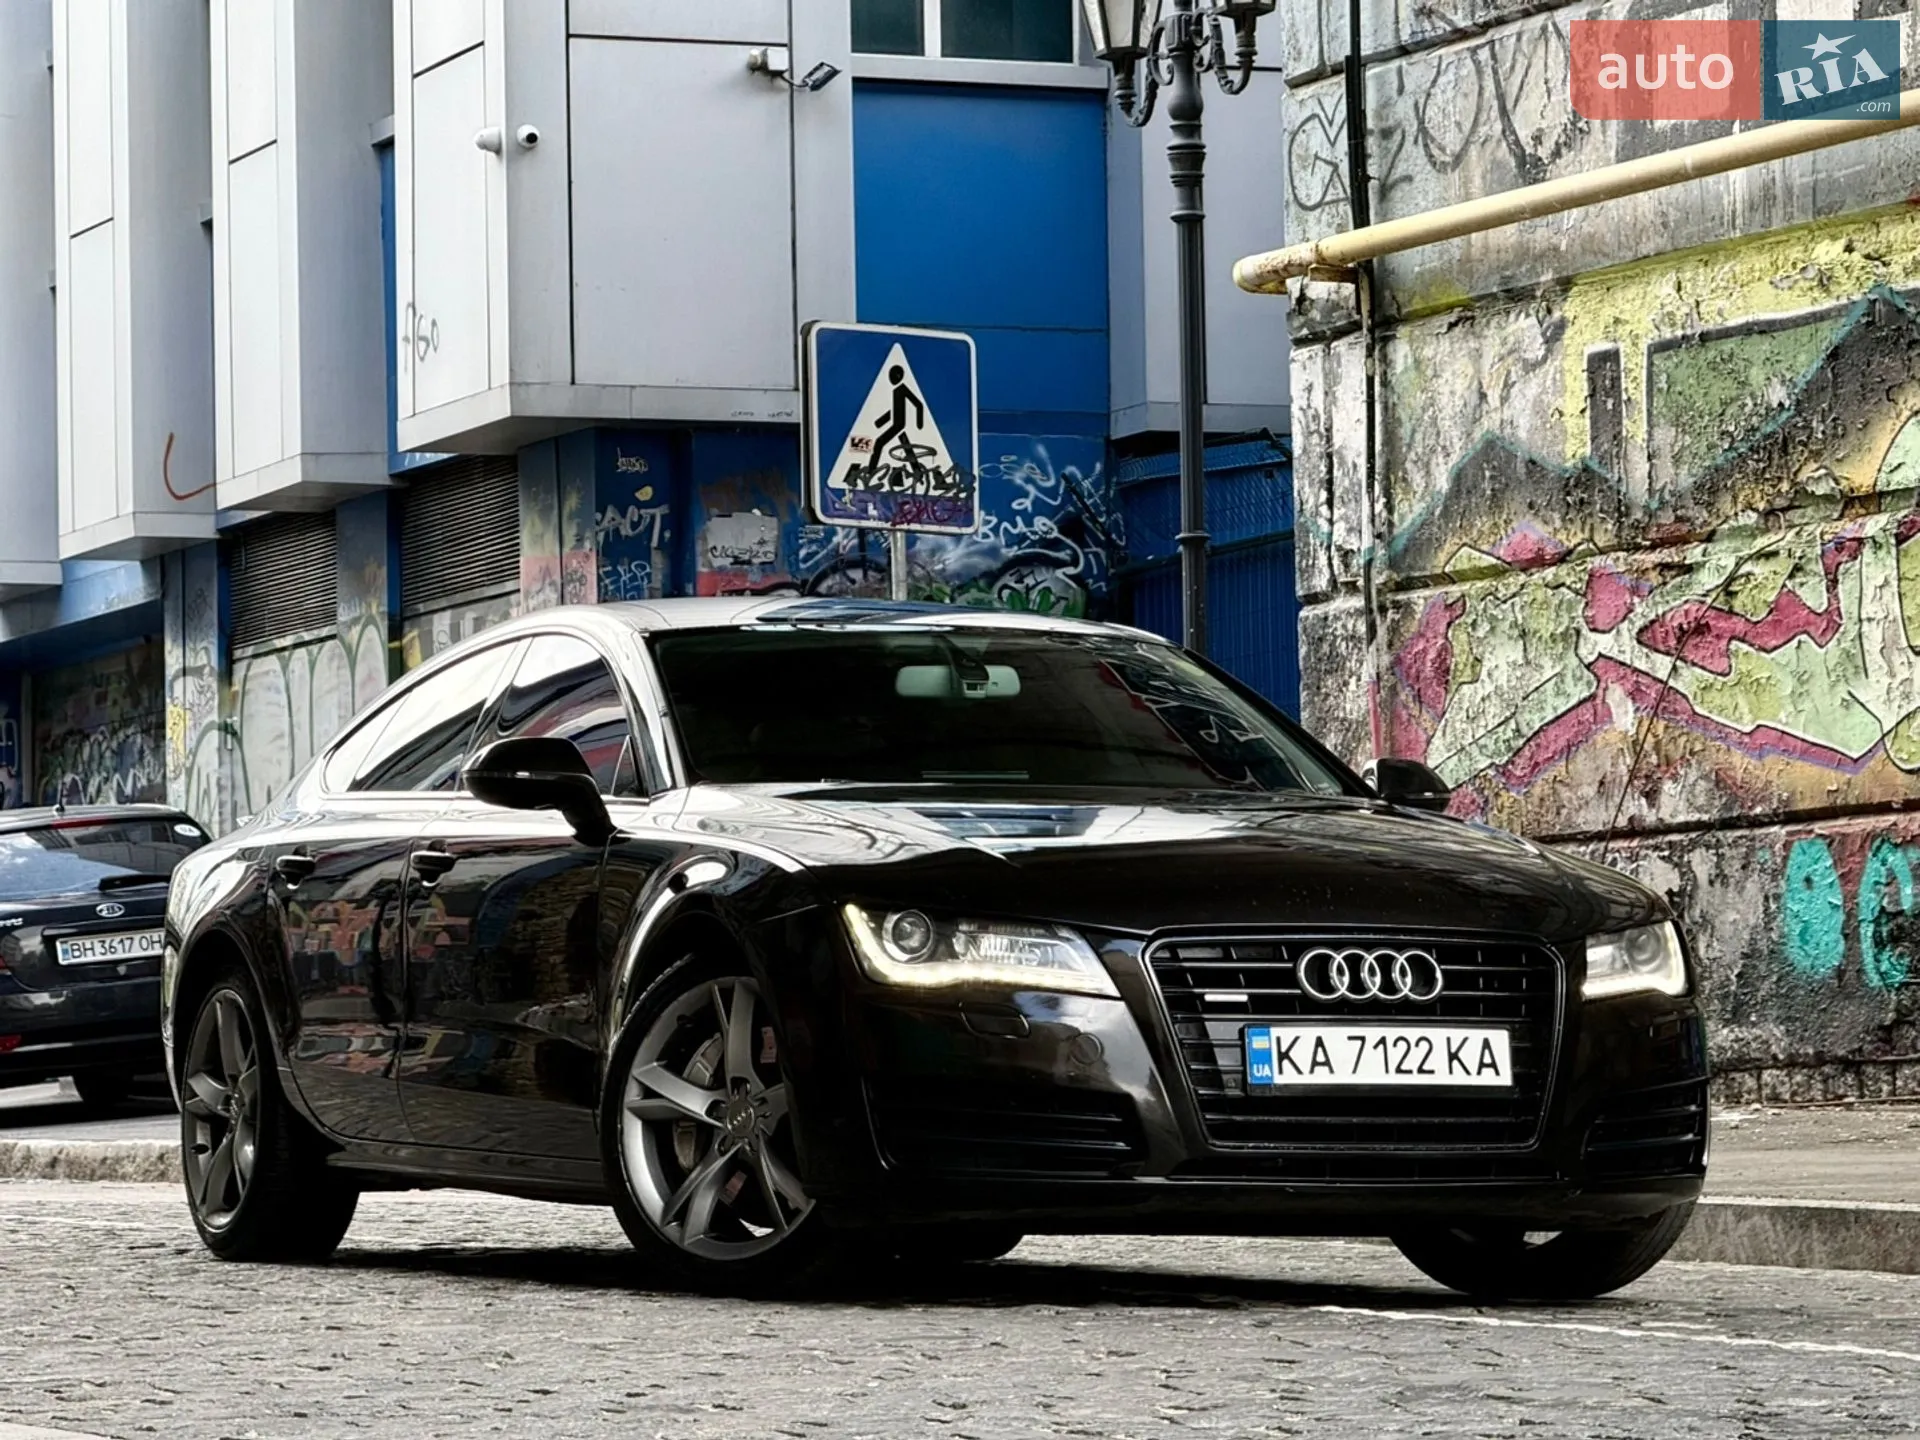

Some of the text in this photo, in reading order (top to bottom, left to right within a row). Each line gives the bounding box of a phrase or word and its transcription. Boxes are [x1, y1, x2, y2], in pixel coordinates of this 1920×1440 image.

[70, 933, 164, 959] BH 3617 OH
[1275, 1035, 1501, 1077] KA 7122 KA
[1253, 1063, 1272, 1077] UA
